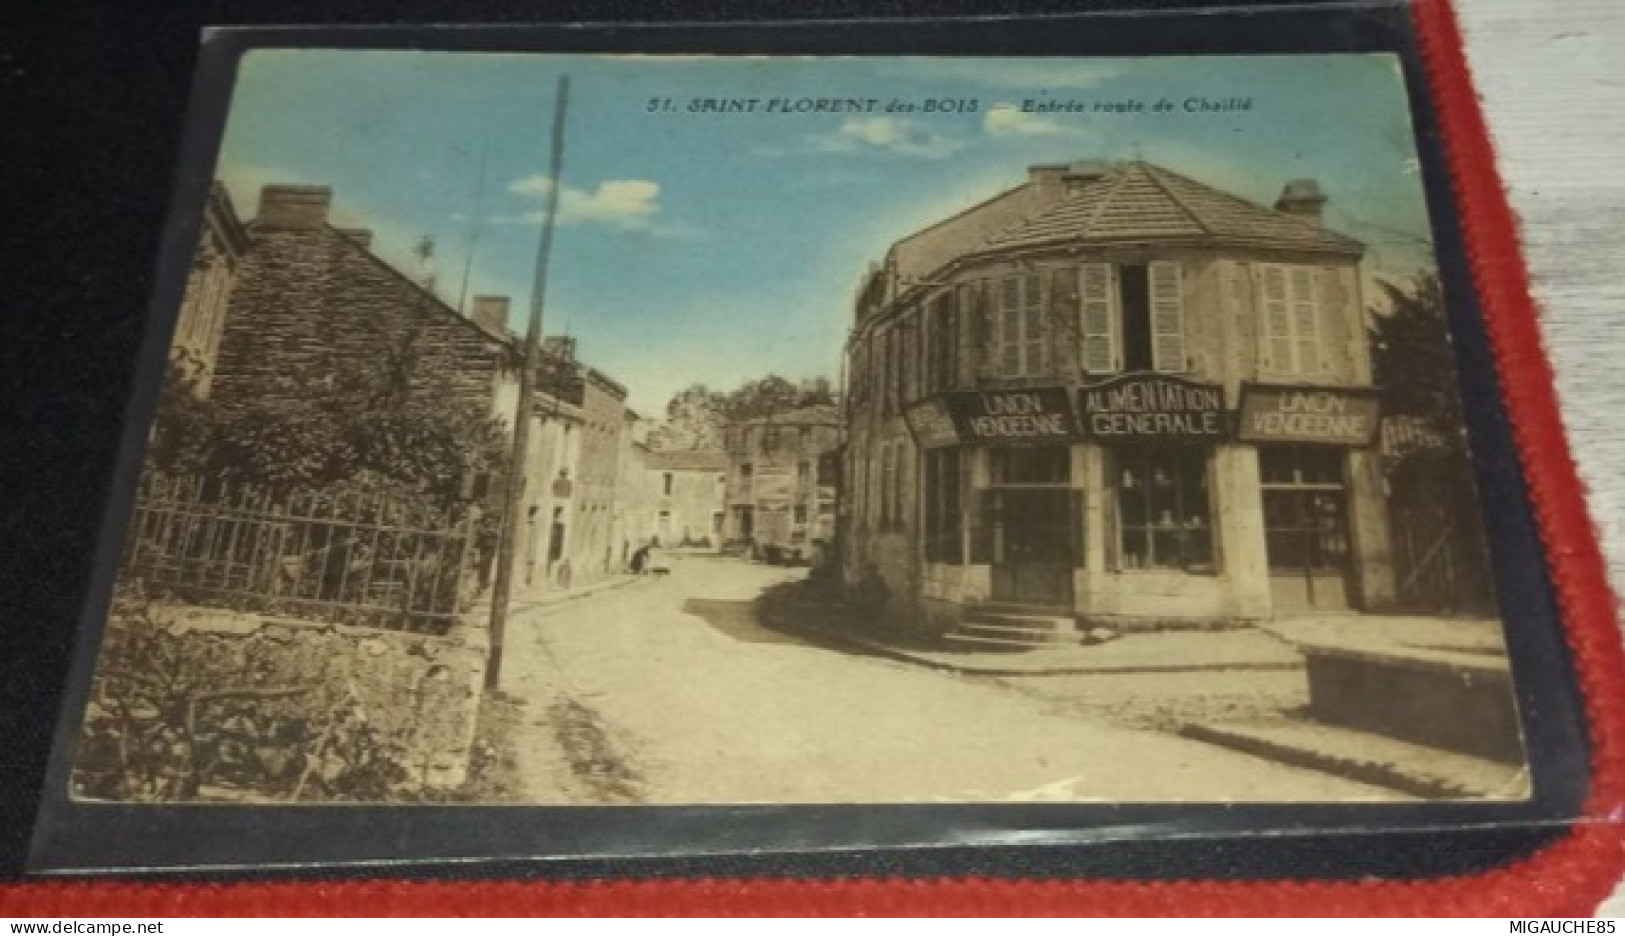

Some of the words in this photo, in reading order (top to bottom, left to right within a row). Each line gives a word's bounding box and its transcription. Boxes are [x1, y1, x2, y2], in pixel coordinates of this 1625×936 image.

[1093, 99, 1145, 113] route
[1152, 97, 1175, 113] de
[981, 392, 1042, 414] UNION
[1086, 381, 1220, 412] ALIMENTATION
[1278, 391, 1346, 412] UNION
[1092, 412, 1221, 435] GENERALE
